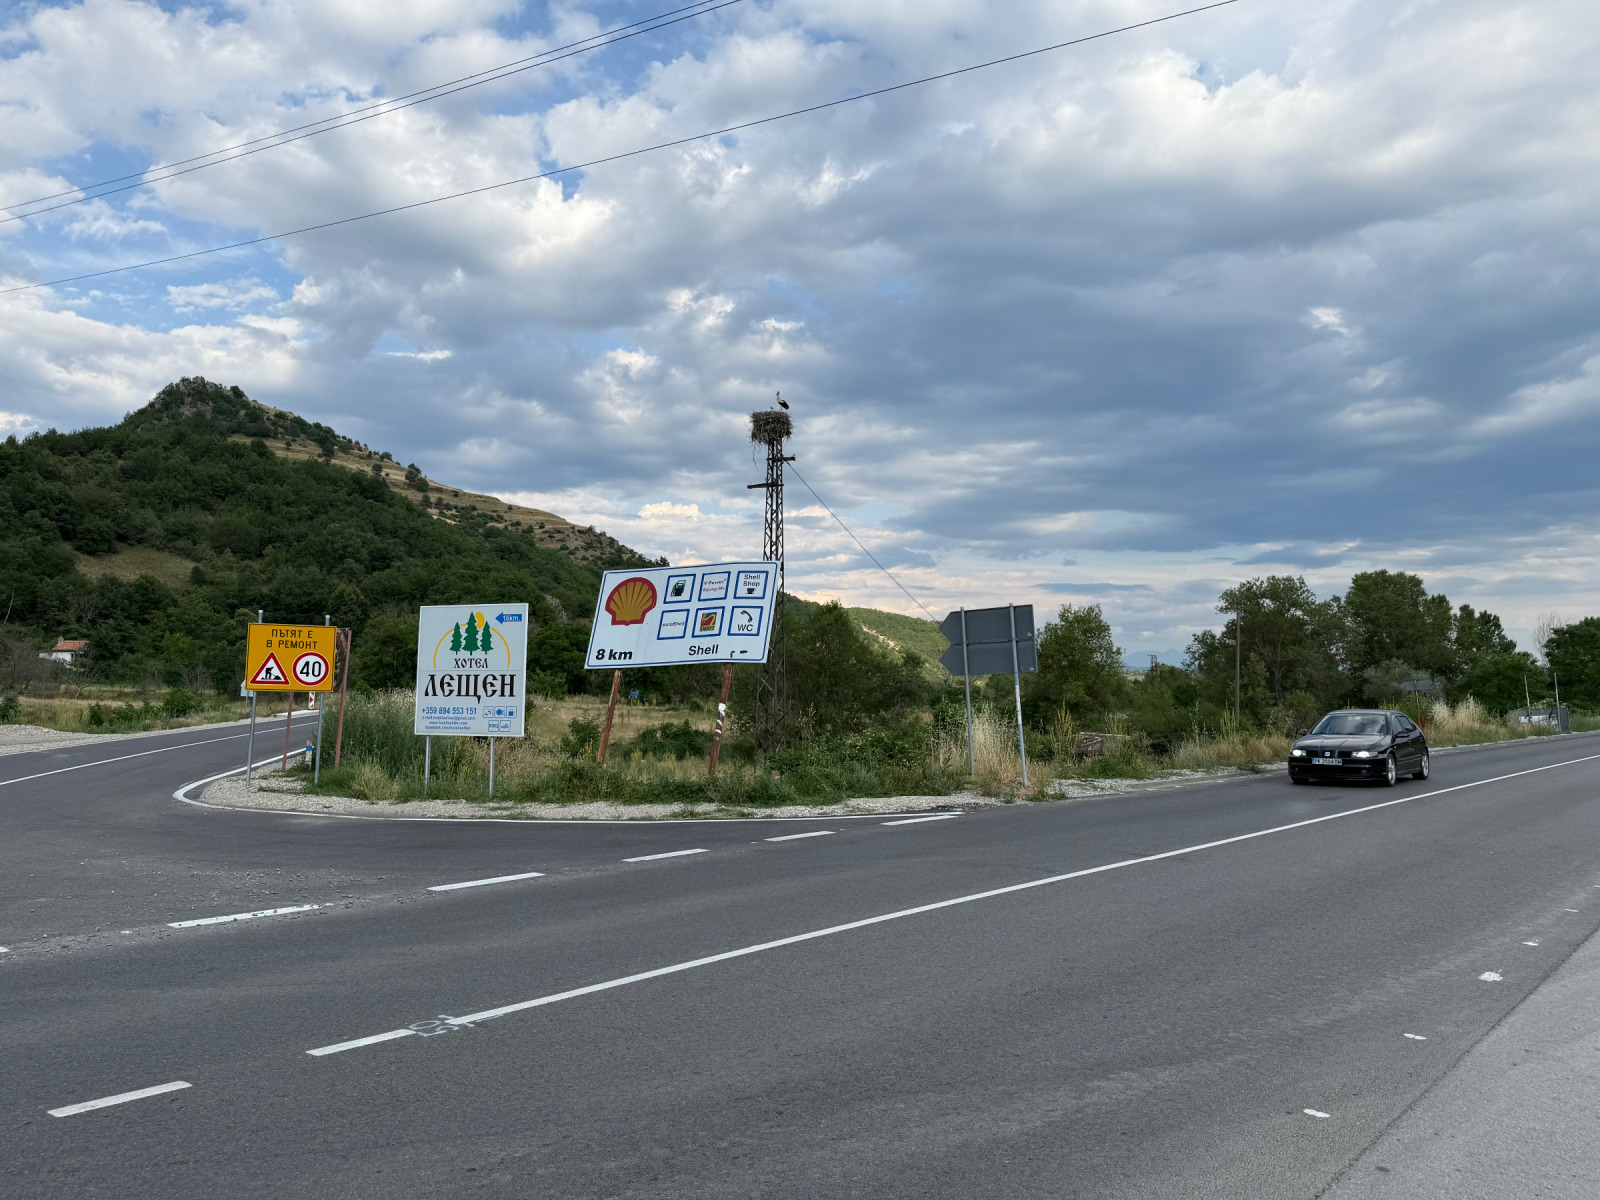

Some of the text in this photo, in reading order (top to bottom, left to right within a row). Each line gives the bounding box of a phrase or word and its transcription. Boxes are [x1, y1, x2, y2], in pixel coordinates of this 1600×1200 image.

[737, 624, 753, 632] WC
[271, 629, 314, 639] ПЪТЯТ Е
[266, 640, 318, 649] В РЕМОНТ
[688, 644, 718, 656] Shell
[595, 648, 633, 660] 8 km
[299, 660, 322, 678] 40
[453, 658, 489, 669] ХОТЕЛ
[424, 673, 517, 704] ЛЕЩЕН
[421, 706, 477, 715] +359 894 553 151
